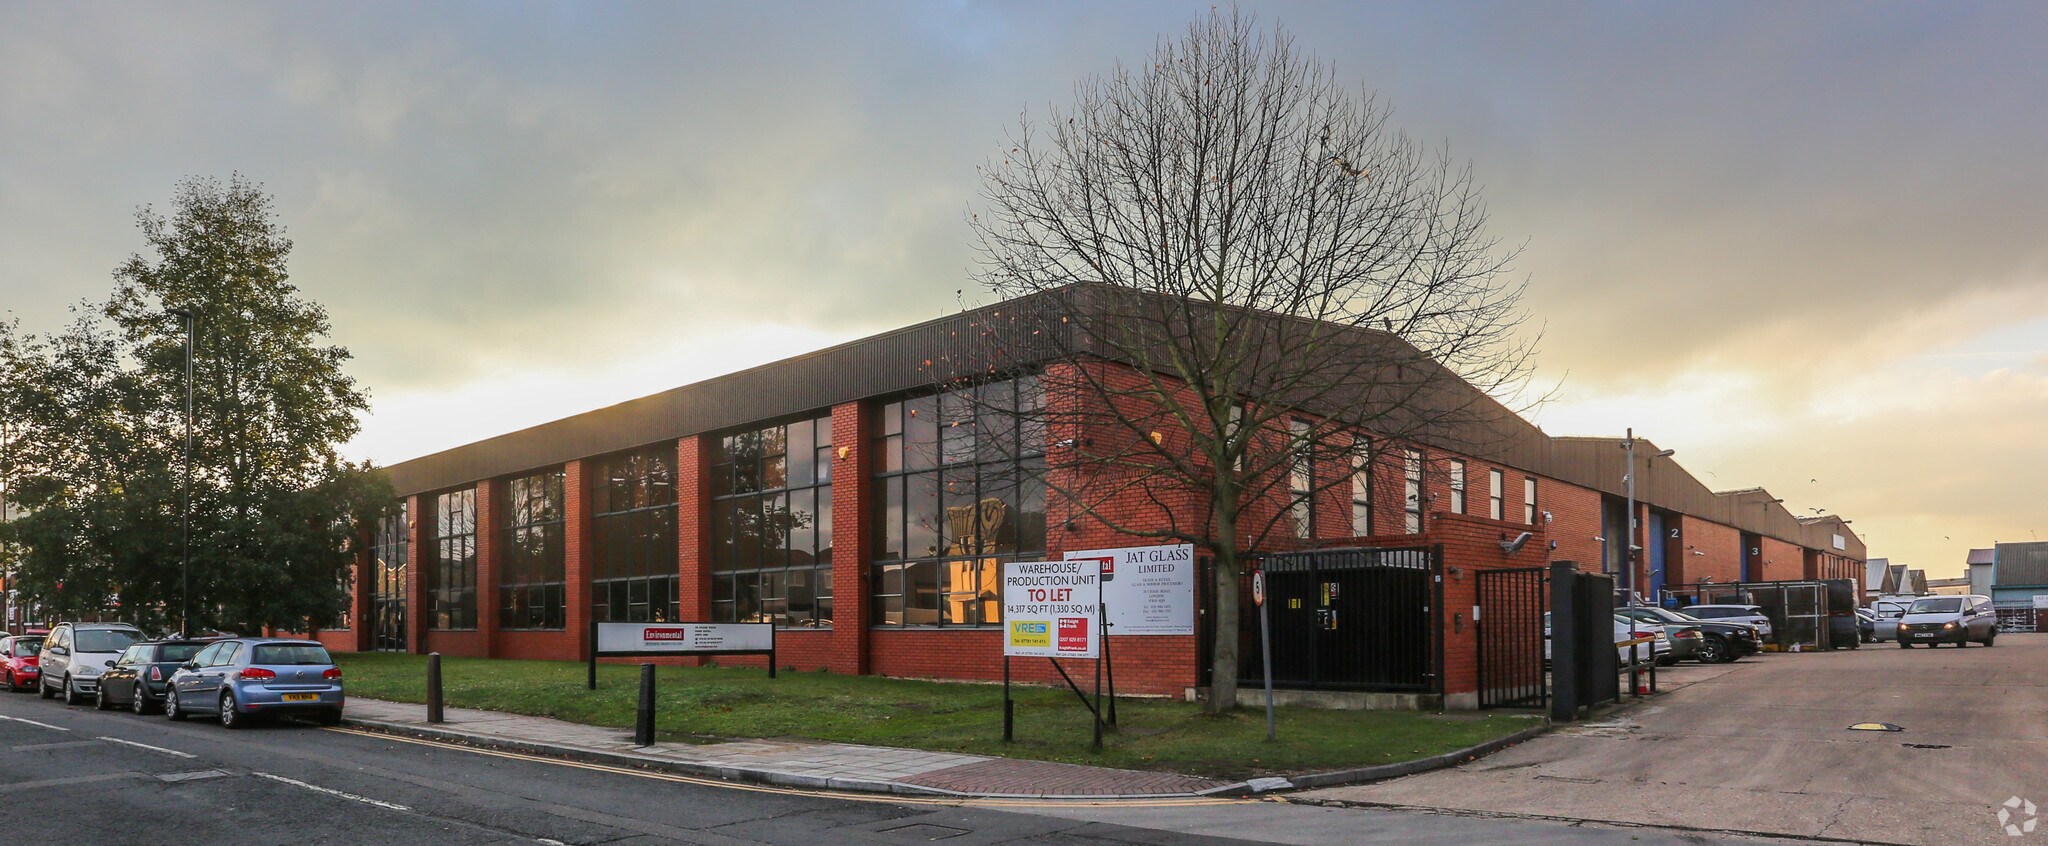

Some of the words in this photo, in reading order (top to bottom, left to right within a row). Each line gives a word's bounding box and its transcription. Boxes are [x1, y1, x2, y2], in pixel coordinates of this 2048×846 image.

[1671, 528, 1679, 538] 2
[1126, 551, 1145, 563] JAT
[1149, 549, 1189, 562] GLASS
[1752, 547, 1759, 556] 3
[1019, 563, 1083, 574] WAREHOUSE/
[1138, 564, 1175, 574] LIMITED
[1007, 576, 1069, 586] PRODUCTION
[1071, 575, 1096, 585] UNIT
[1256, 581, 1260, 594] 5
[1028, 589, 1046, 602] TO
[1050, 588, 1073, 602] LET
[1027, 605, 1038, 614] SQ
[1040, 605, 1048, 613] FT
[1071, 604, 1083, 614] SQ
[1085, 604, 1095, 615] M)
[1014, 623, 1034, 633] VRE
[645, 630, 682, 639] Environmental
